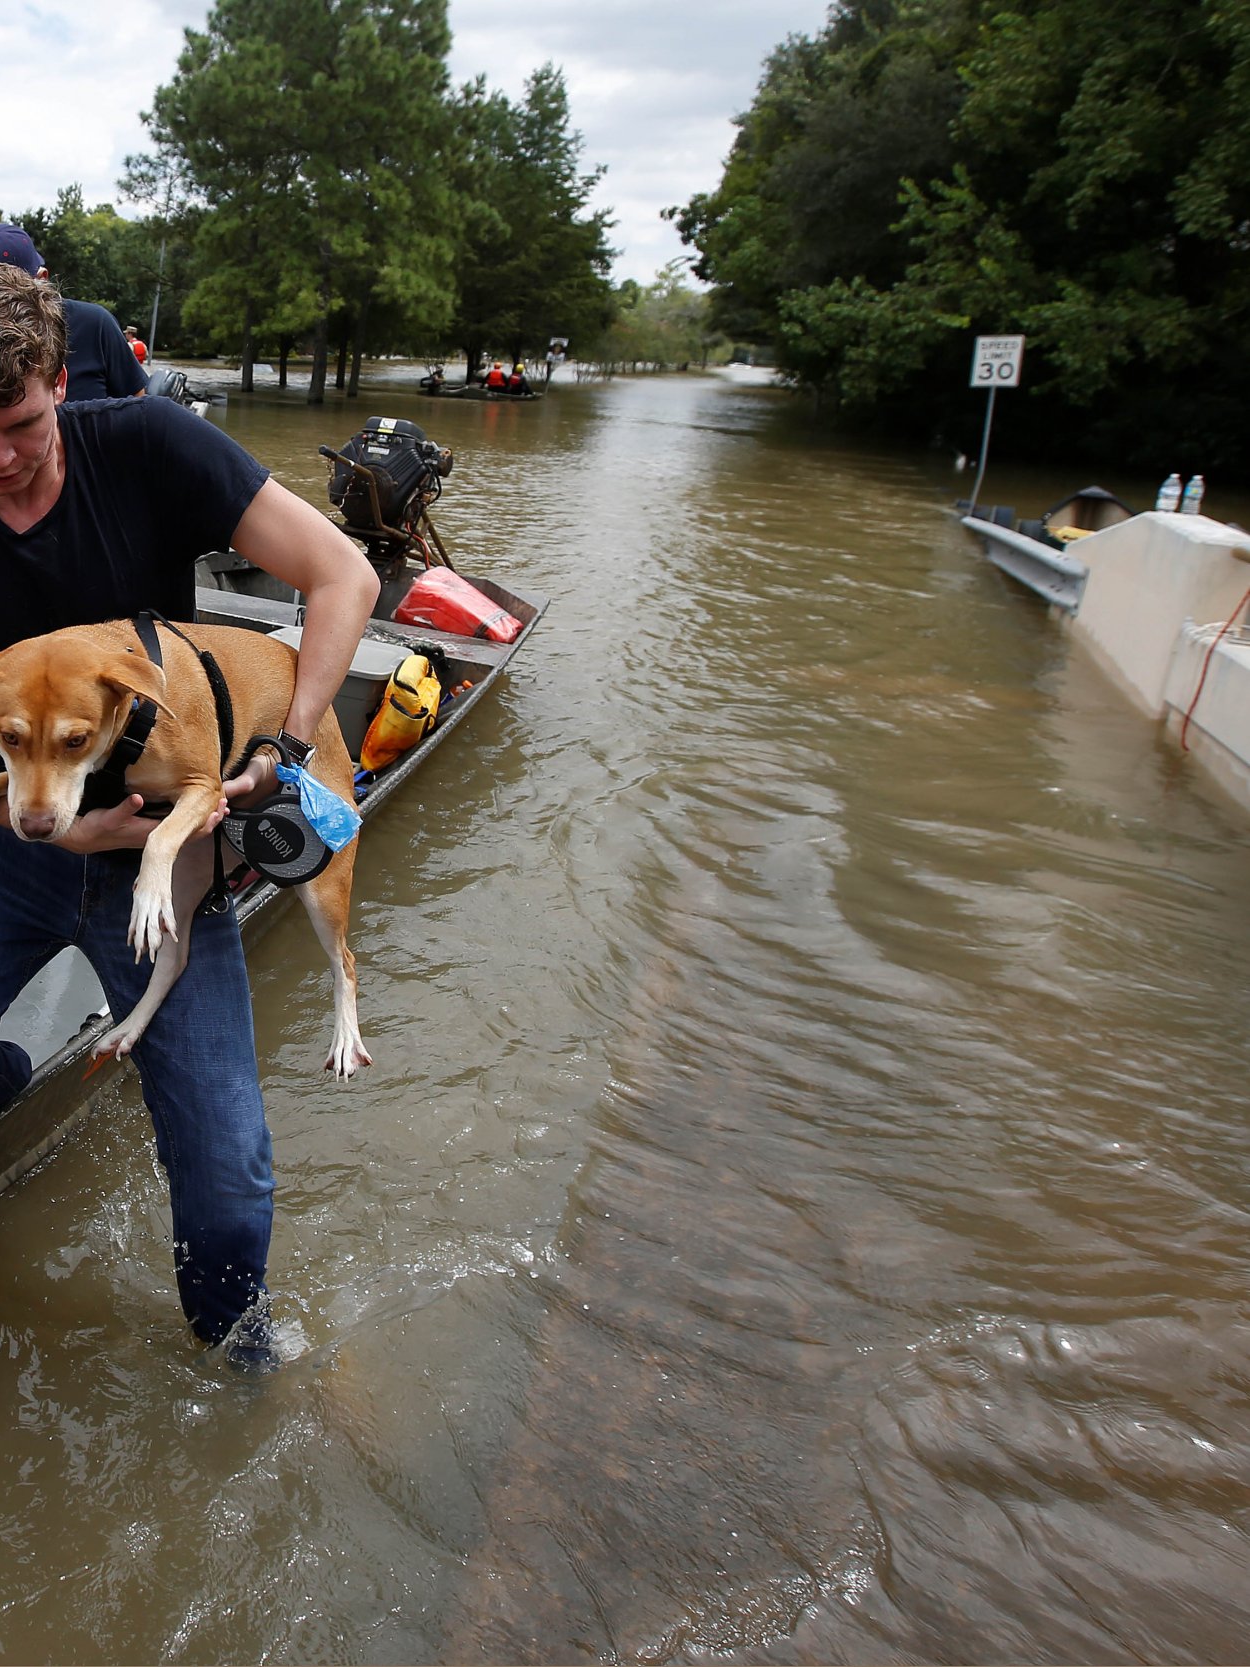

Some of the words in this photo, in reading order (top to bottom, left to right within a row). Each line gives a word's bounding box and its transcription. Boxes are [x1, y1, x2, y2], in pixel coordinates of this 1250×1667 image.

[981, 341, 1019, 350] SPEED
[978, 362, 1014, 380] 30
[264, 828, 294, 858] KONG
